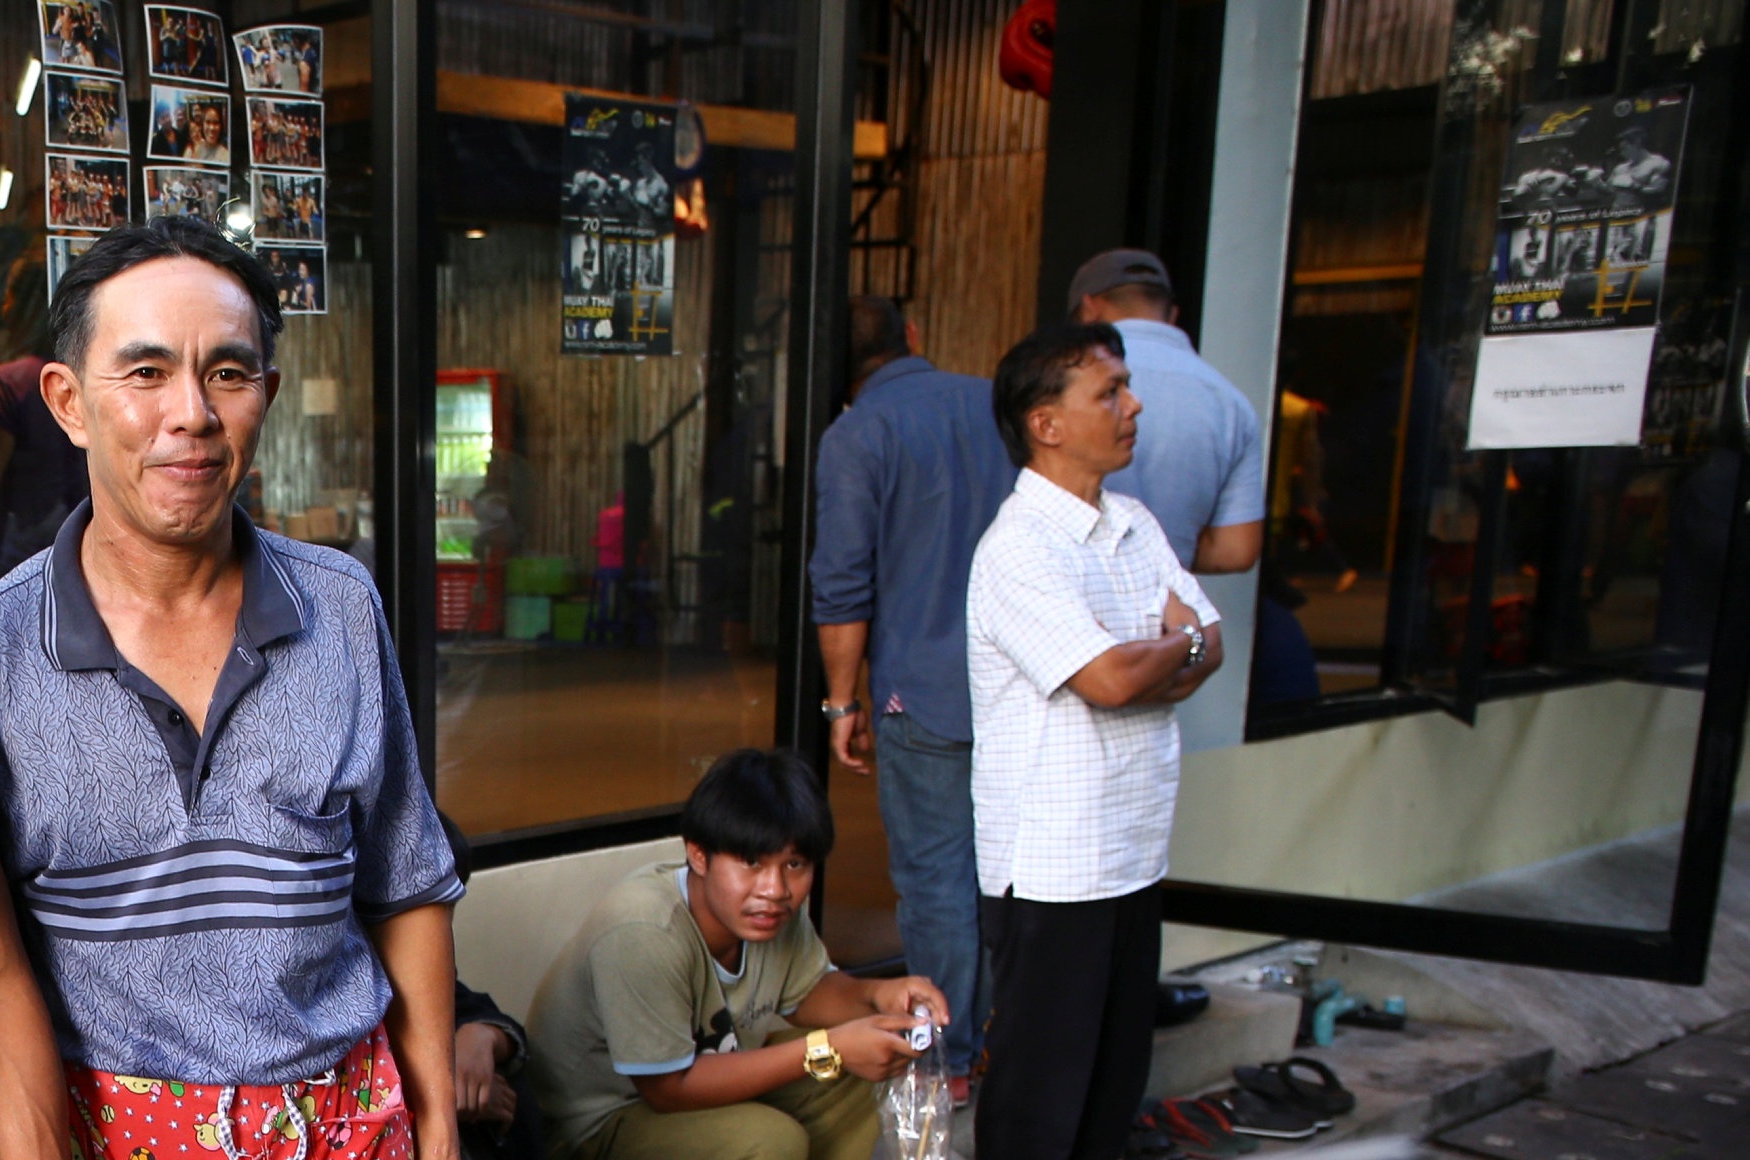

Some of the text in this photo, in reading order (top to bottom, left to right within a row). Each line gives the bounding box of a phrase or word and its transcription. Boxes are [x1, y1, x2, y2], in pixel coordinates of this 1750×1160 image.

[582, 217, 600, 232] 70
[1526, 210, 1552, 225] 70
[1492, 290, 1564, 305] ACADEMY
[564, 306, 614, 318] ACADEMY
